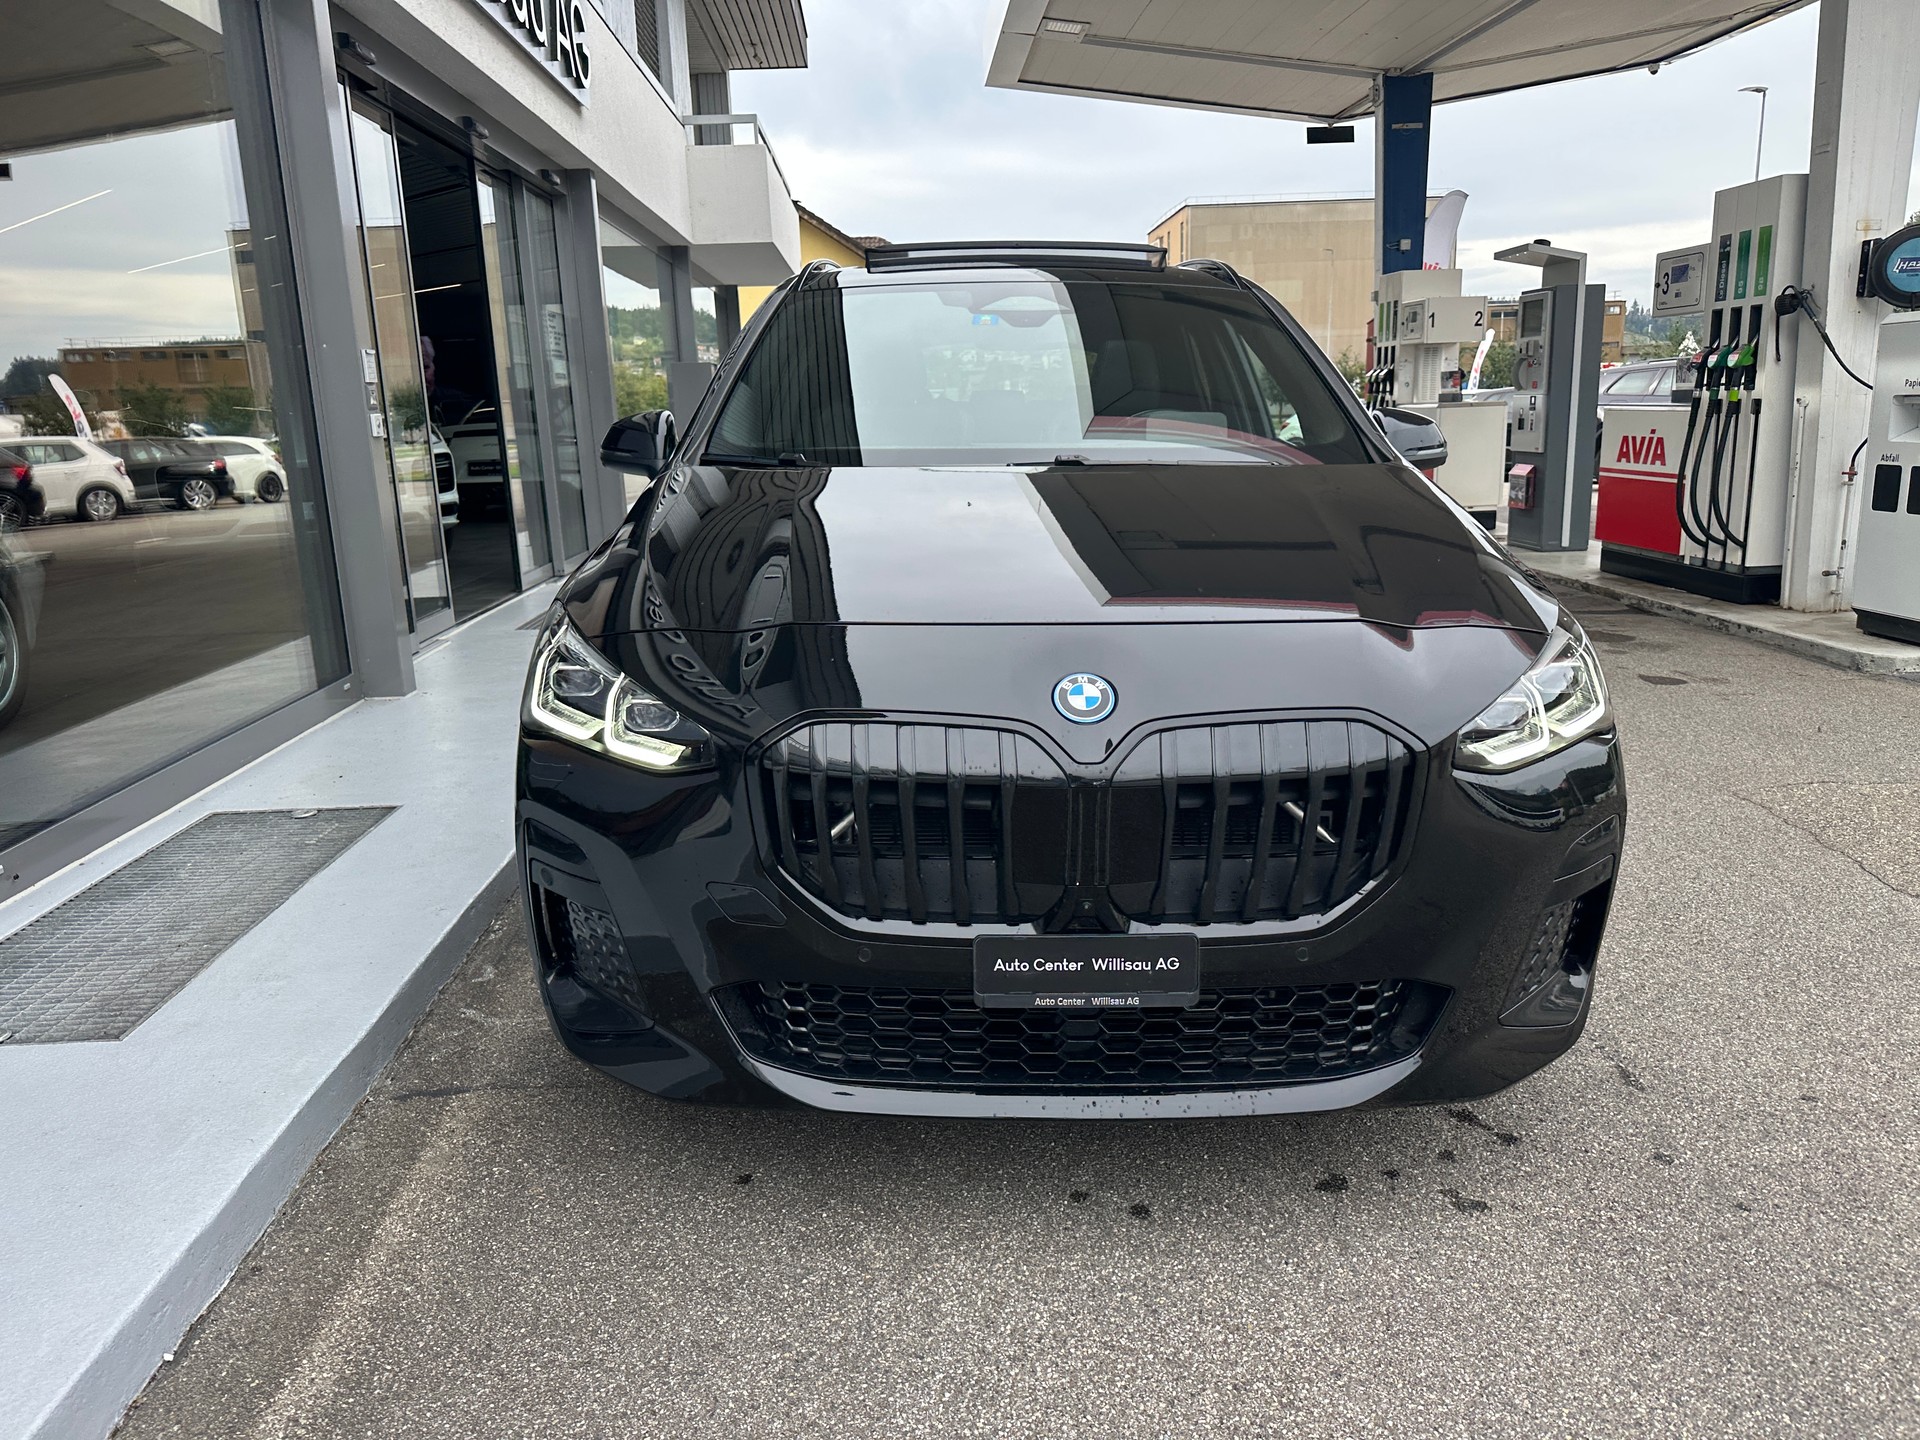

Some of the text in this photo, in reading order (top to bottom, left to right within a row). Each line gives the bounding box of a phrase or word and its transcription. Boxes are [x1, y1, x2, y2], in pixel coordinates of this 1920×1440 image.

[556, 0, 592, 89] AG
[1662, 272, 1669, 295] 3
[1429, 312, 1435, 328] 1
[1474, 311, 1483, 327] 2
[1880, 453, 1900, 462] Abfall
[1061, 676, 1107, 690] BMW
[993, 957, 1180, 971] Auto Center Willisau AG
[1034, 997, 1140, 1006] Auto Center Willisau AG
